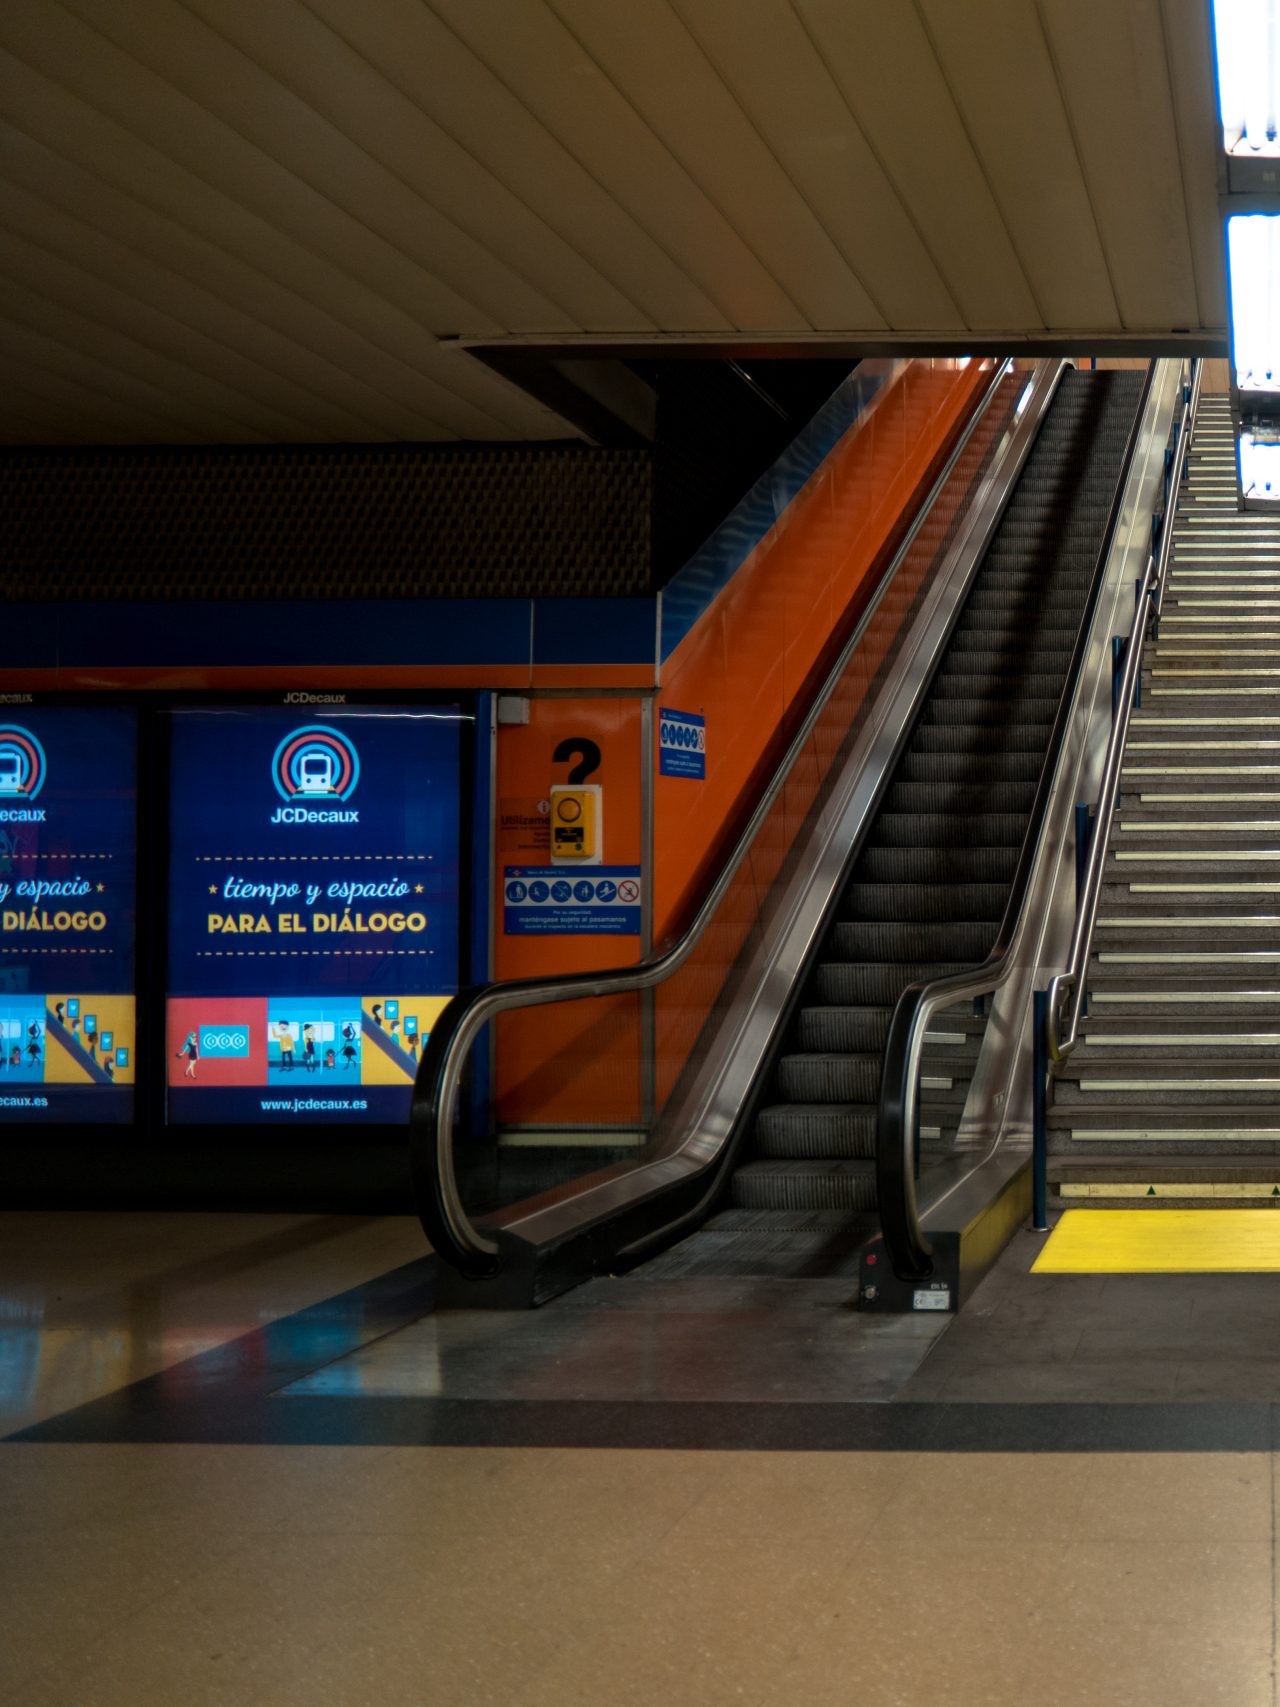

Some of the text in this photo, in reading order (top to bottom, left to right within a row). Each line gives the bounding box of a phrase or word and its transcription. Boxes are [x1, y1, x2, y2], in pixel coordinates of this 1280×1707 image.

[283, 692, 346, 704] JCDecaux
[270, 807, 360, 824] JCDecaux
[15, 876, 93, 905] espacio
[223, 875, 411, 906] tiempo y espacio
[2, 906, 107, 932] DIÁLOGO
[208, 907, 428, 934] PARA EL DIÁLOGO
[260, 1098, 368, 1113] www.jcdecaux.es
